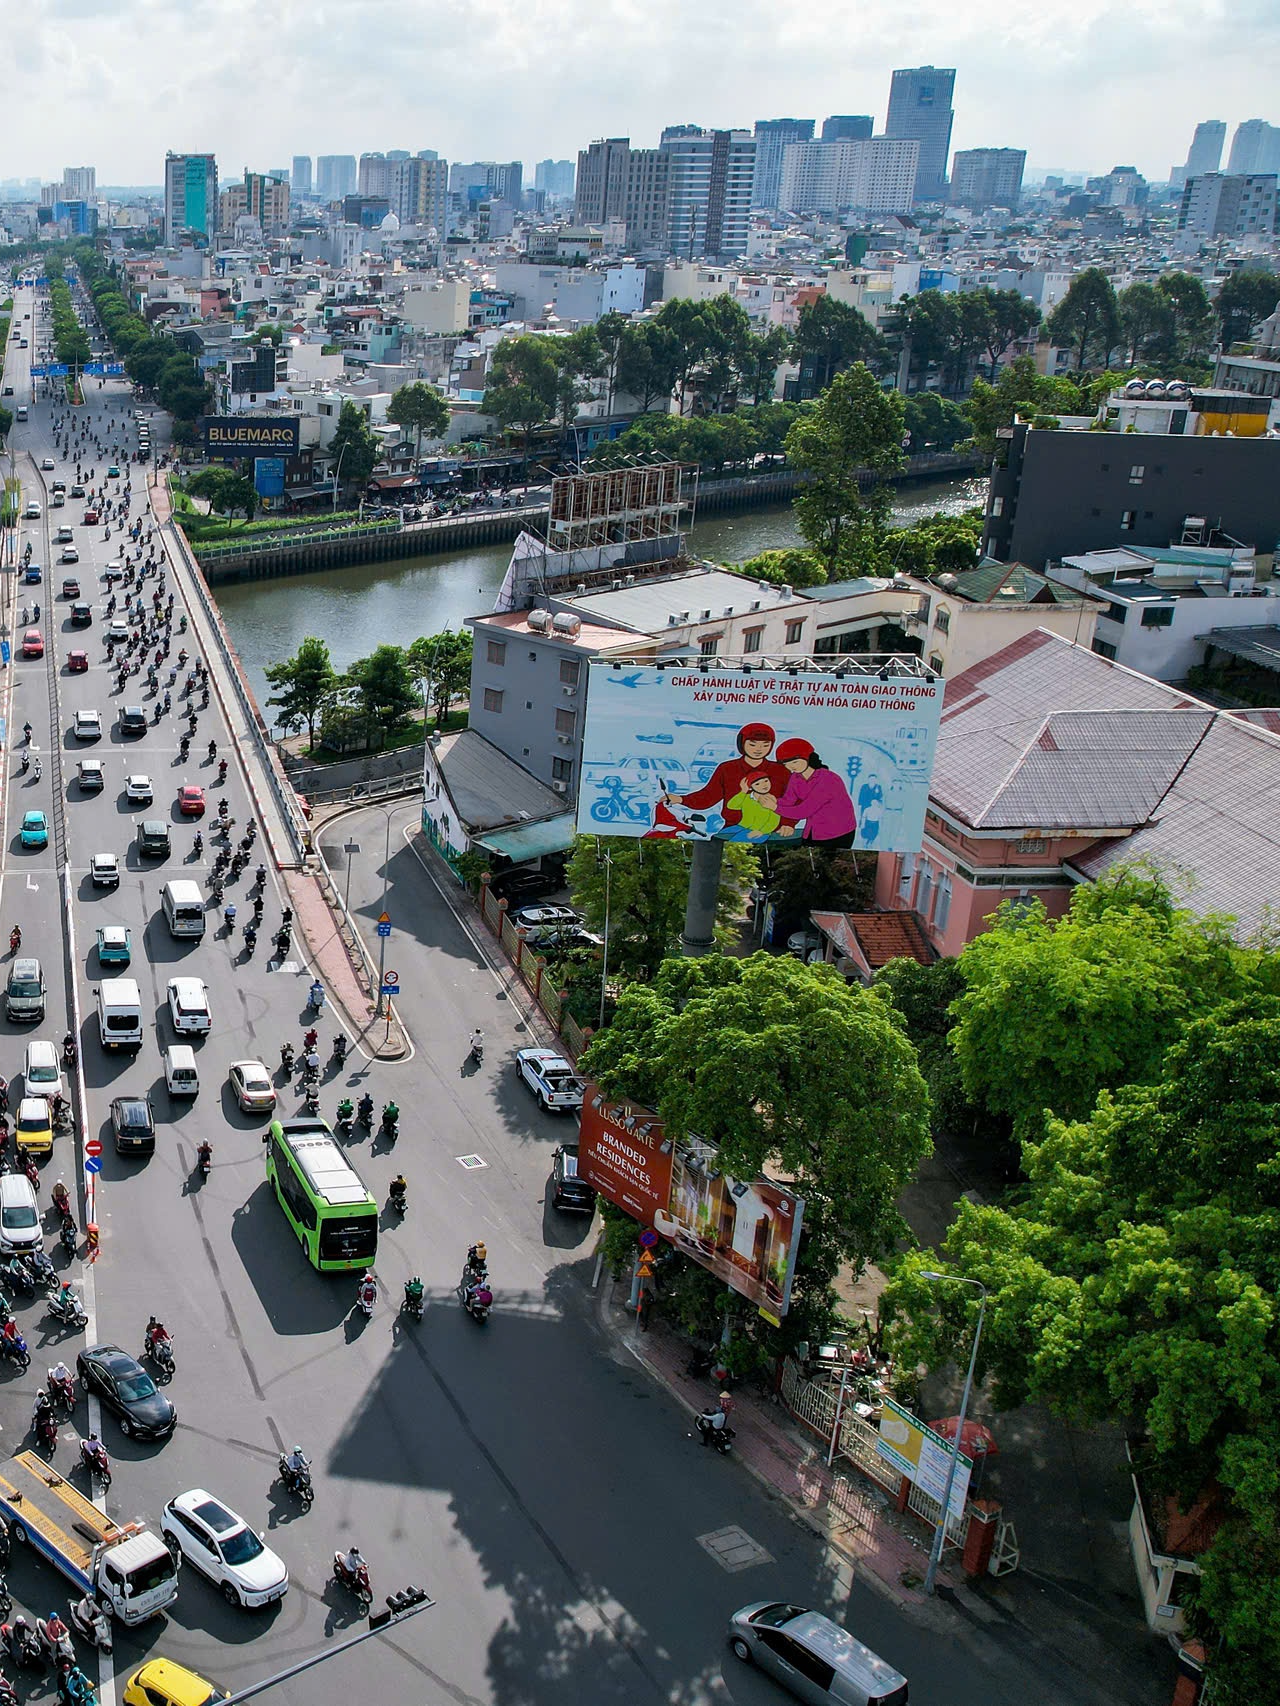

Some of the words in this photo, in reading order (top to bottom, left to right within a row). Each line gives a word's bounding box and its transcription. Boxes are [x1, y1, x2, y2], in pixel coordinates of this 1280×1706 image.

[209, 427, 294, 442] BLUEMARQ
[671, 674, 700, 687] CHẤP
[702, 675, 732, 688] HÀNH
[735, 677, 761, 691] LUẬT
[763, 676, 777, 690] VỀ
[778, 679, 804, 693] TRẬT
[807, 682, 822, 694] TỰ
[823, 683, 838, 693] AN
[841, 682, 869, 694] TOÀN
[871, 685, 897, 695] GIAO
[899, 684, 936, 697] THÔNG
[693, 690, 714, 702] XÂY
[716, 692, 746, 704] DỰNG
[748, 691, 769, 703] NẾP
[771, 692, 801, 705] SỐNG
[803, 694, 824, 706] VĂN
[826, 696, 849, 708] HÓA
[851, 698, 877, 709] GIAO
[880, 698, 916, 711] THÔNG
[603, 1131, 647, 1167] BRANDED
[596, 1142, 651, 1185] RESIDENCES
